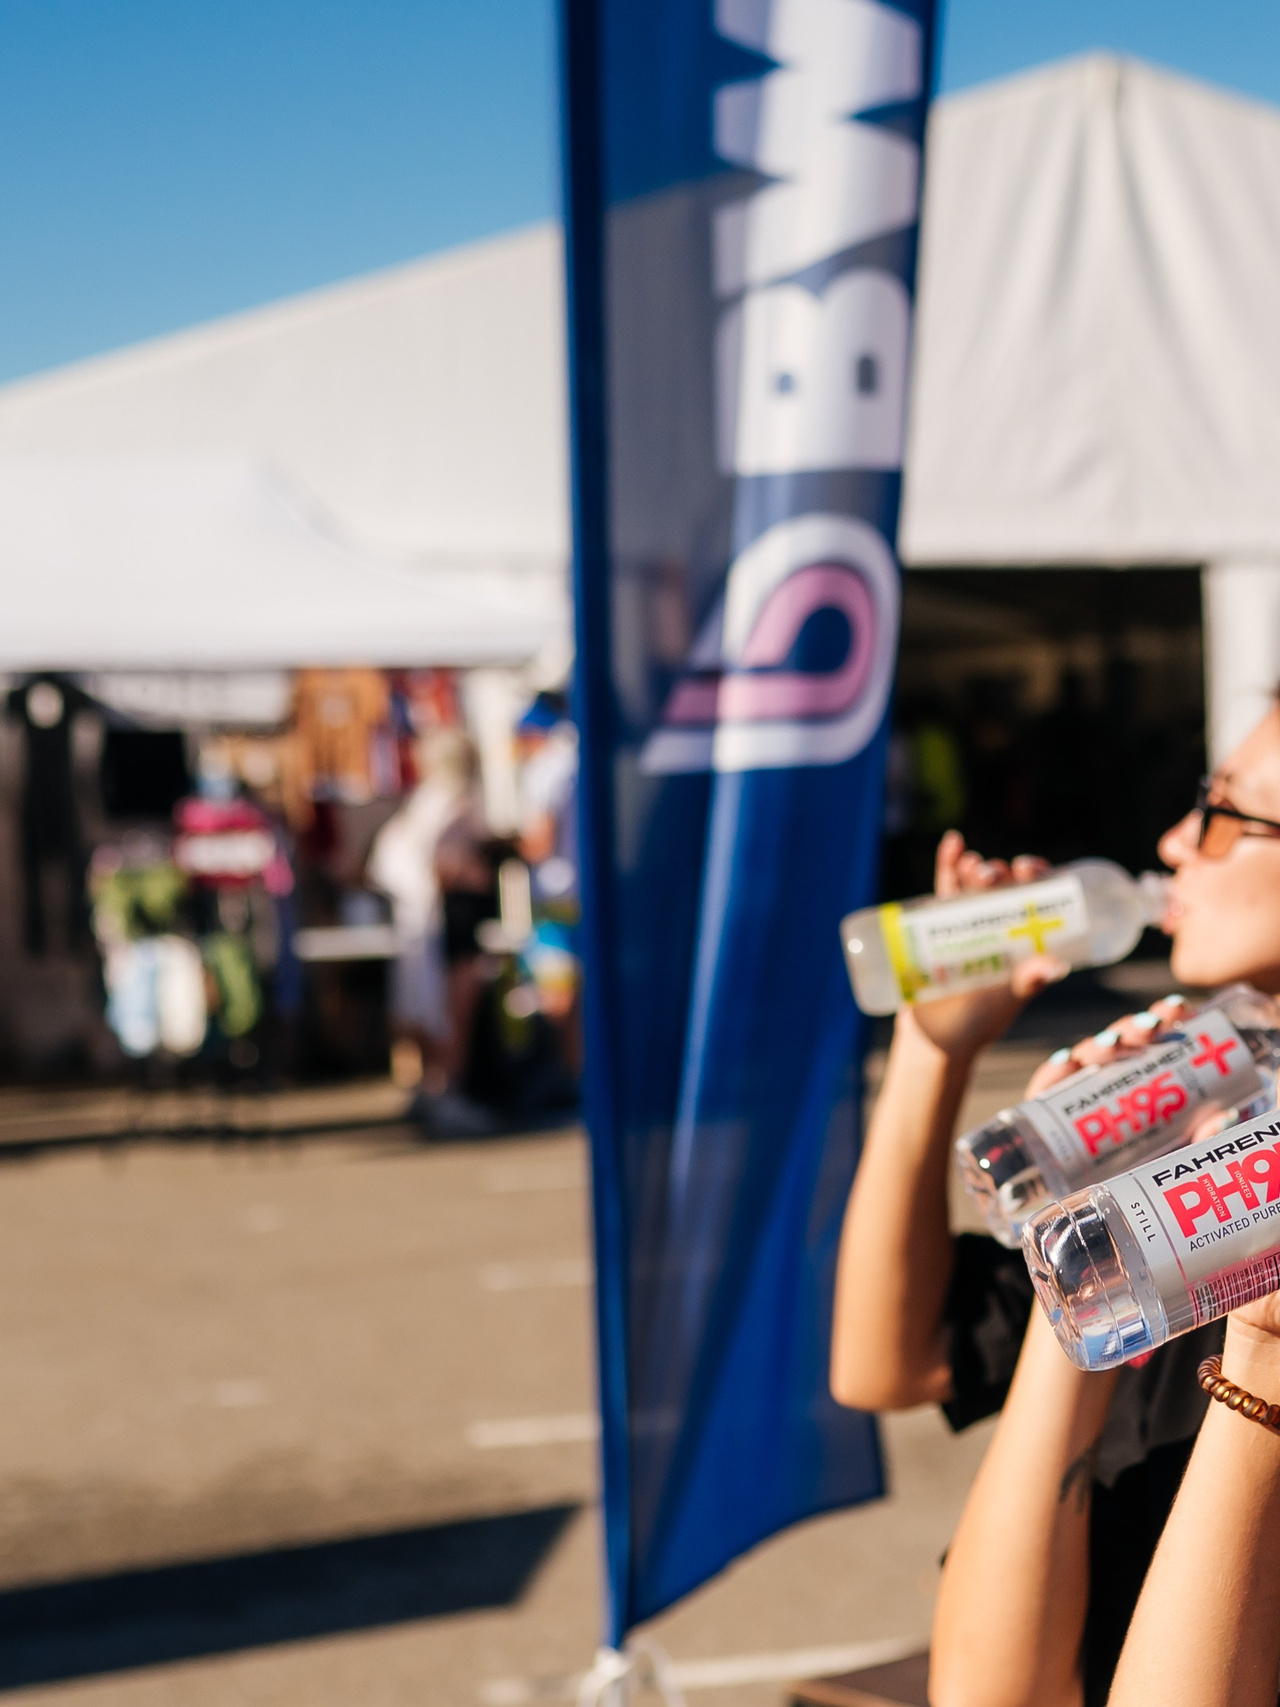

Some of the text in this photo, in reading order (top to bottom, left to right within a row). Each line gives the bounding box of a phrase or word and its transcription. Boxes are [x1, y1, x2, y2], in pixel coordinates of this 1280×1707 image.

[1202, 1178, 1227, 1218] HYDRATION
[1234, 1170, 1252, 1199] IONIZED
[1130, 1202, 1156, 1243] STILL
[1189, 1217, 1251, 1252] ACTIVATED
